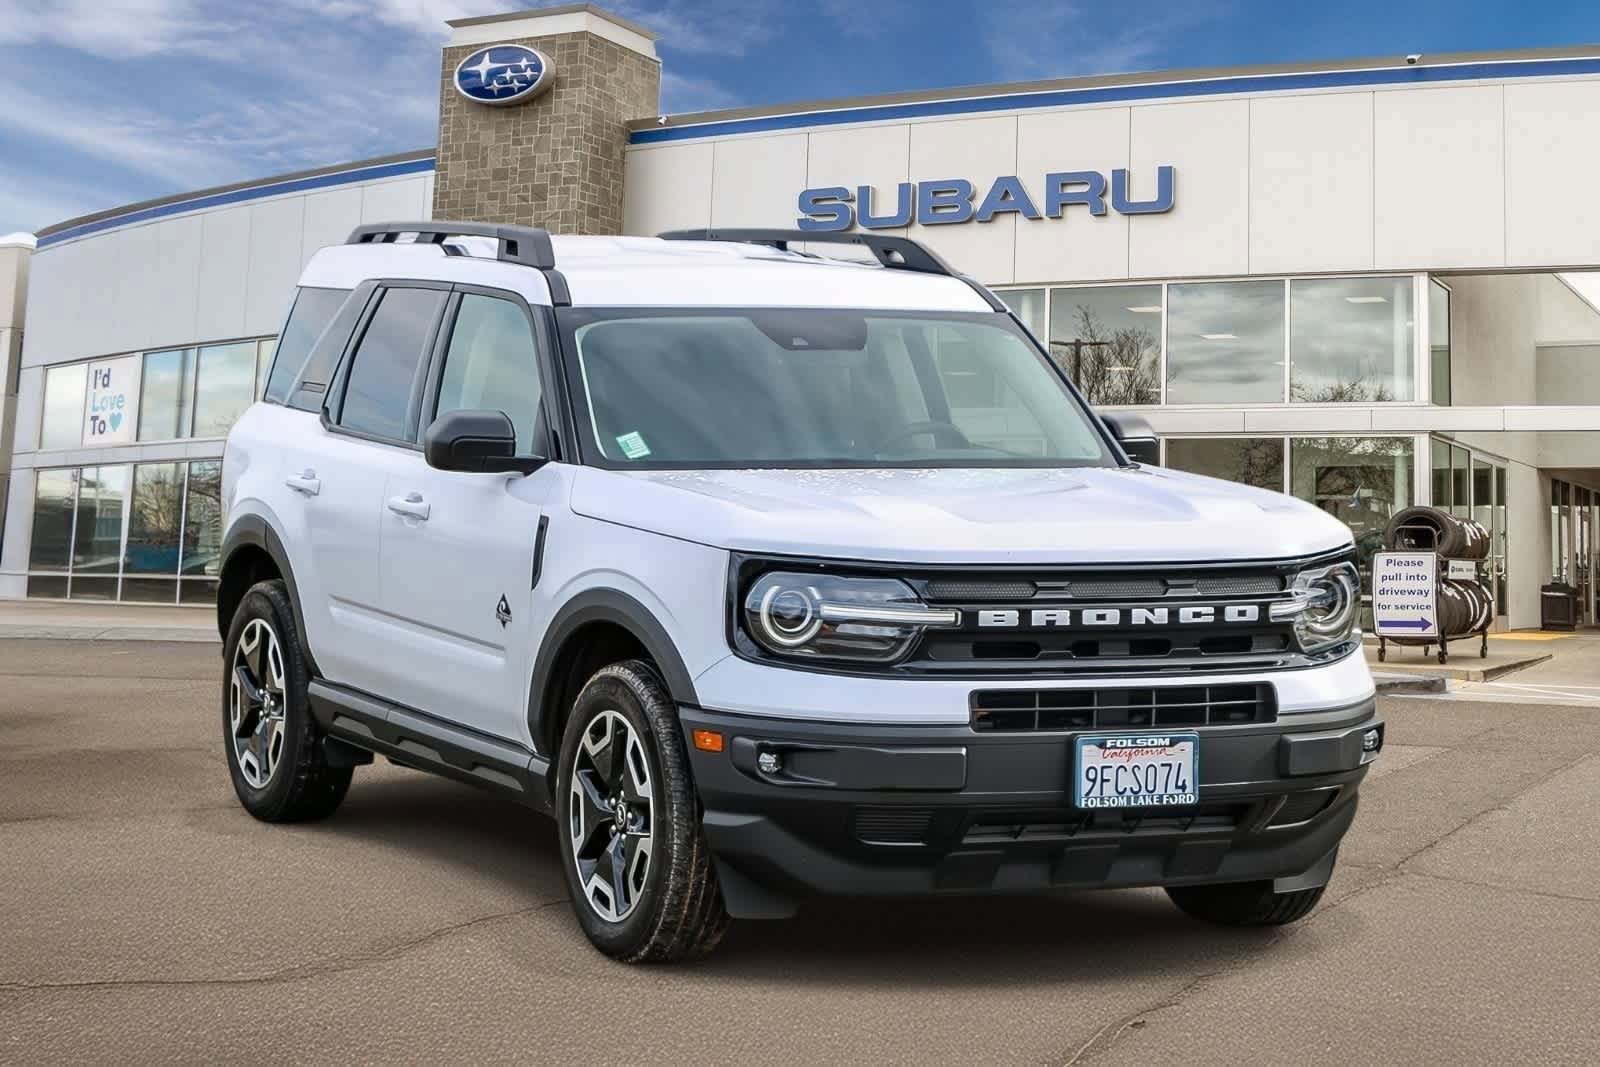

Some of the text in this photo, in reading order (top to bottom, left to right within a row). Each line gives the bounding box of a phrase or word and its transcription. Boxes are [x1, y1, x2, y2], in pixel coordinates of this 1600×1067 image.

[797, 165, 1176, 232] SUBARU
[93, 367, 111, 389] I'd
[91, 392, 125, 412] Love
[90, 415, 106, 435] To
[1386, 558, 1424, 567] Please
[1381, 573, 1428, 583] pull into
[1378, 587, 1430, 598] driveway
[1377, 602, 1391, 610] for
[978, 605, 1259, 627] BRONCO
[1106, 738, 1170, 748] FOLSOM
[1102, 747, 1169, 762] California
[1084, 762, 1187, 797] 9FCS074
[1081, 793, 1195, 808] FOLSOM LAKE FORD
